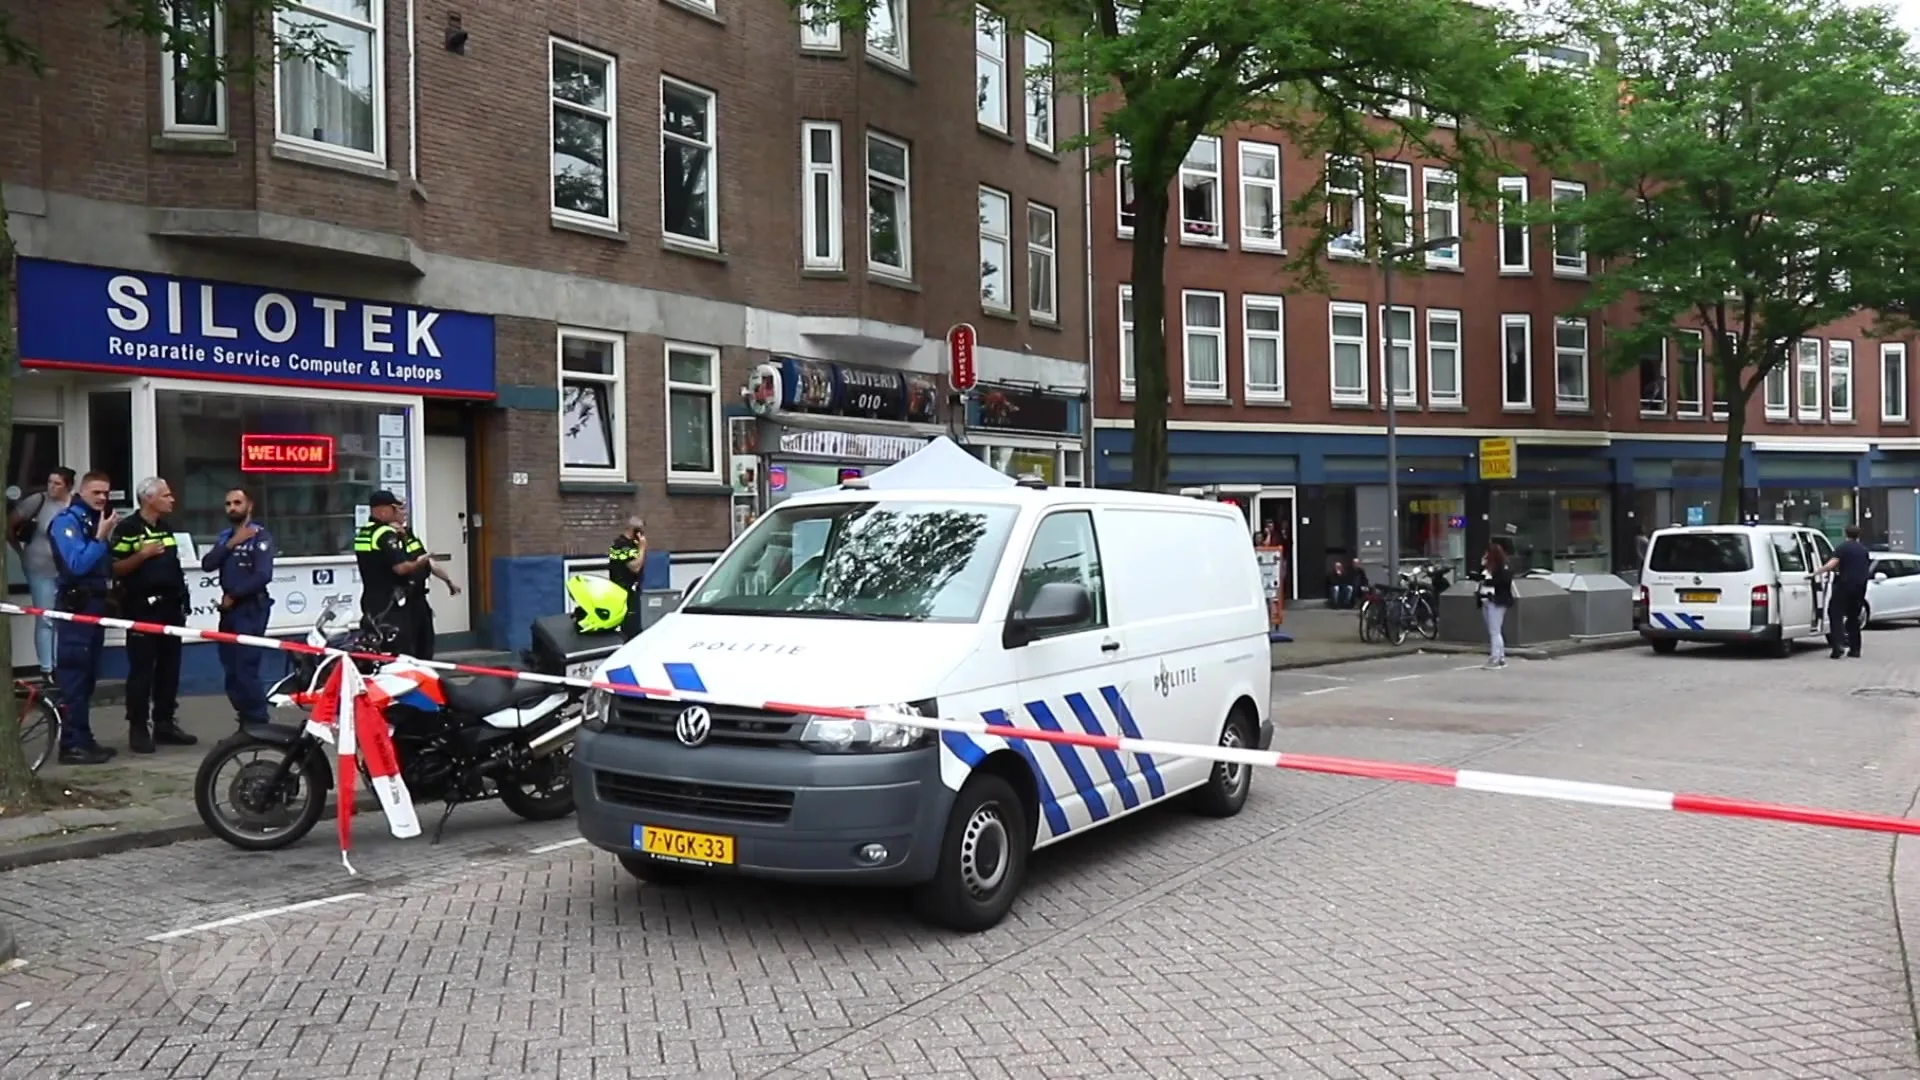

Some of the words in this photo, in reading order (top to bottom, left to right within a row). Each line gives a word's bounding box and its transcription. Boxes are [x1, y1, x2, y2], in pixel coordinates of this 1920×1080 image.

[107, 275, 442, 358] SILOTEK
[109, 336, 205, 361] Reparatie
[213, 346, 281, 368] Service
[289, 353, 363, 376] Computer
[370, 360, 380, 376] &
[387, 362, 442, 383] Laptops
[841, 368, 898, 389] SLIJTERIJ
[247, 445, 323, 462] WELKOM
[688, 640, 807, 655] POLITIE
[1154, 661, 1197, 697] POLITIE
[648, 830, 725, 859] 7-VGK-33
